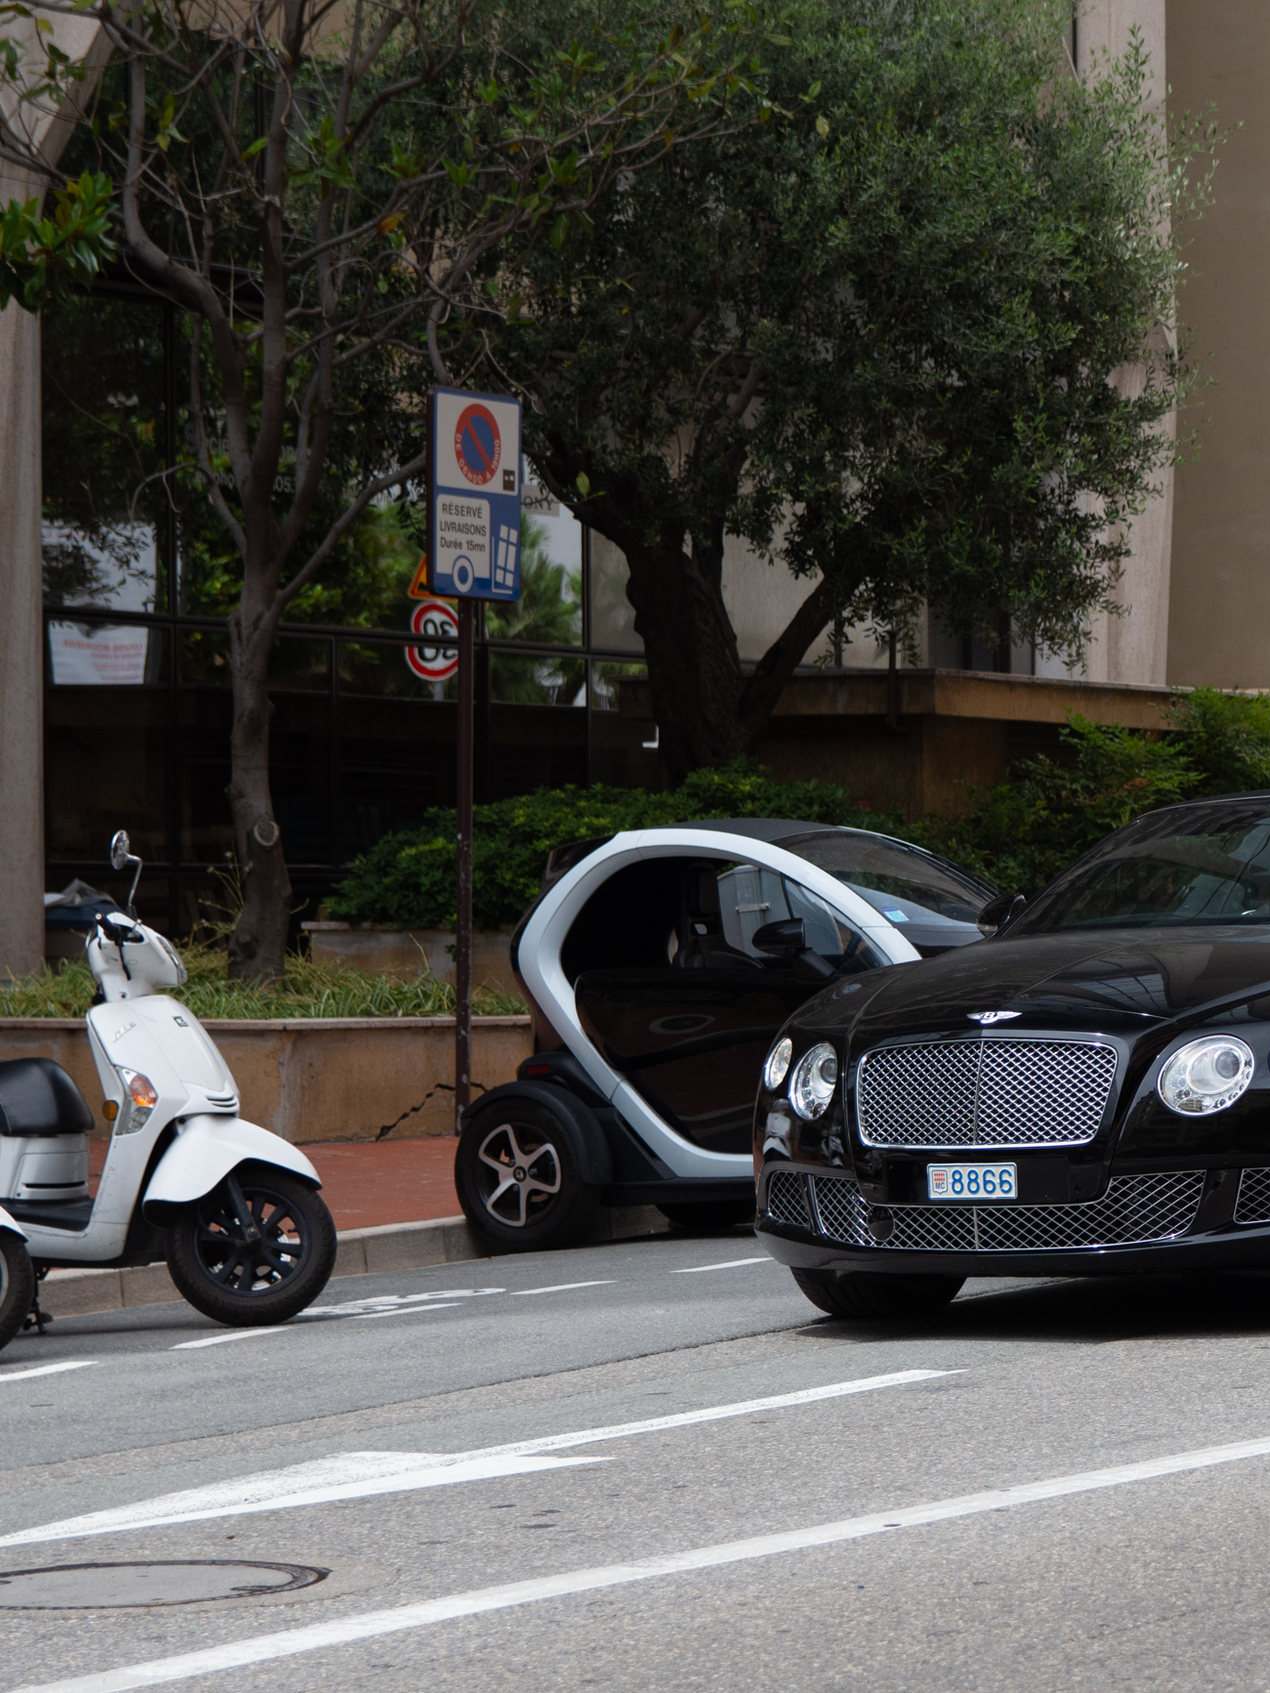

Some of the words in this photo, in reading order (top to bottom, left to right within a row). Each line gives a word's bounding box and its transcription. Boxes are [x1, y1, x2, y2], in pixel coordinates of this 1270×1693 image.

[455, 433, 462, 452] DE
[442, 501, 483, 519] RÉSERVÉ
[439, 520, 487, 537] LIVRAISONS
[440, 536, 463, 550] Durée
[466, 539, 486, 553] 15mn
[935, 1182, 946, 1190] MC
[951, 1168, 1013, 1195] 8866
